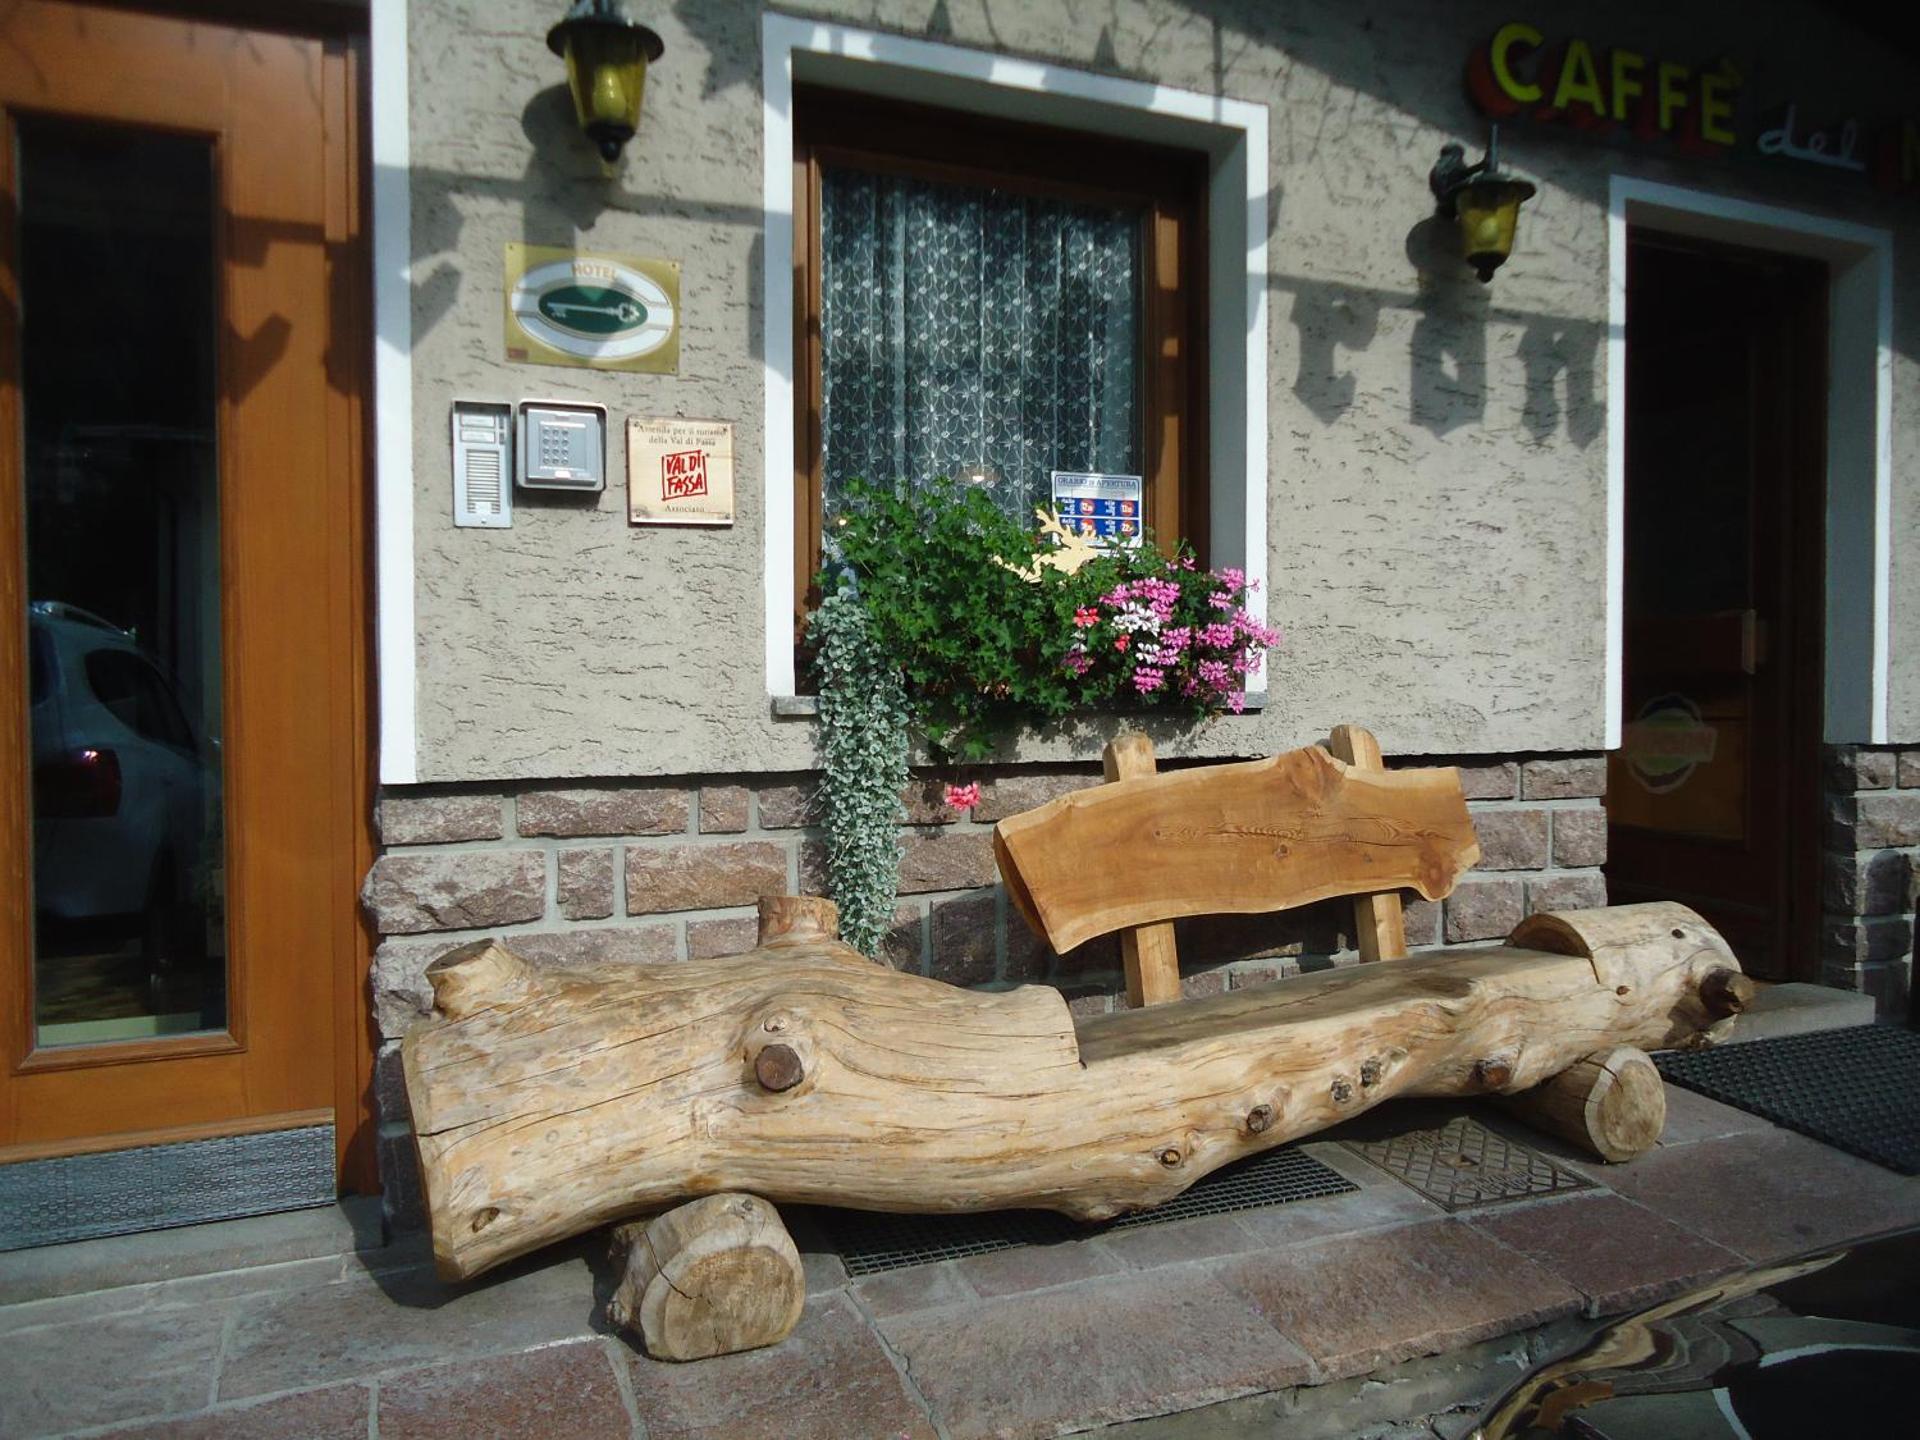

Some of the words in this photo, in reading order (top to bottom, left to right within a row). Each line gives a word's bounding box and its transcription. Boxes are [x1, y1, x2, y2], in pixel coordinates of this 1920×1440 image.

[1757, 103, 1865, 172] del
[571, 263, 617, 281] HOTEL
[648, 435, 667, 444] della
[671, 436, 682, 444] Val
[686, 436, 693, 445] di
[697, 438, 716, 446] Fassa
[673, 427, 686, 435] per
[667, 454, 687, 475] VAL
[689, 450, 700, 471] DI
[667, 473, 703, 496] FASSA
